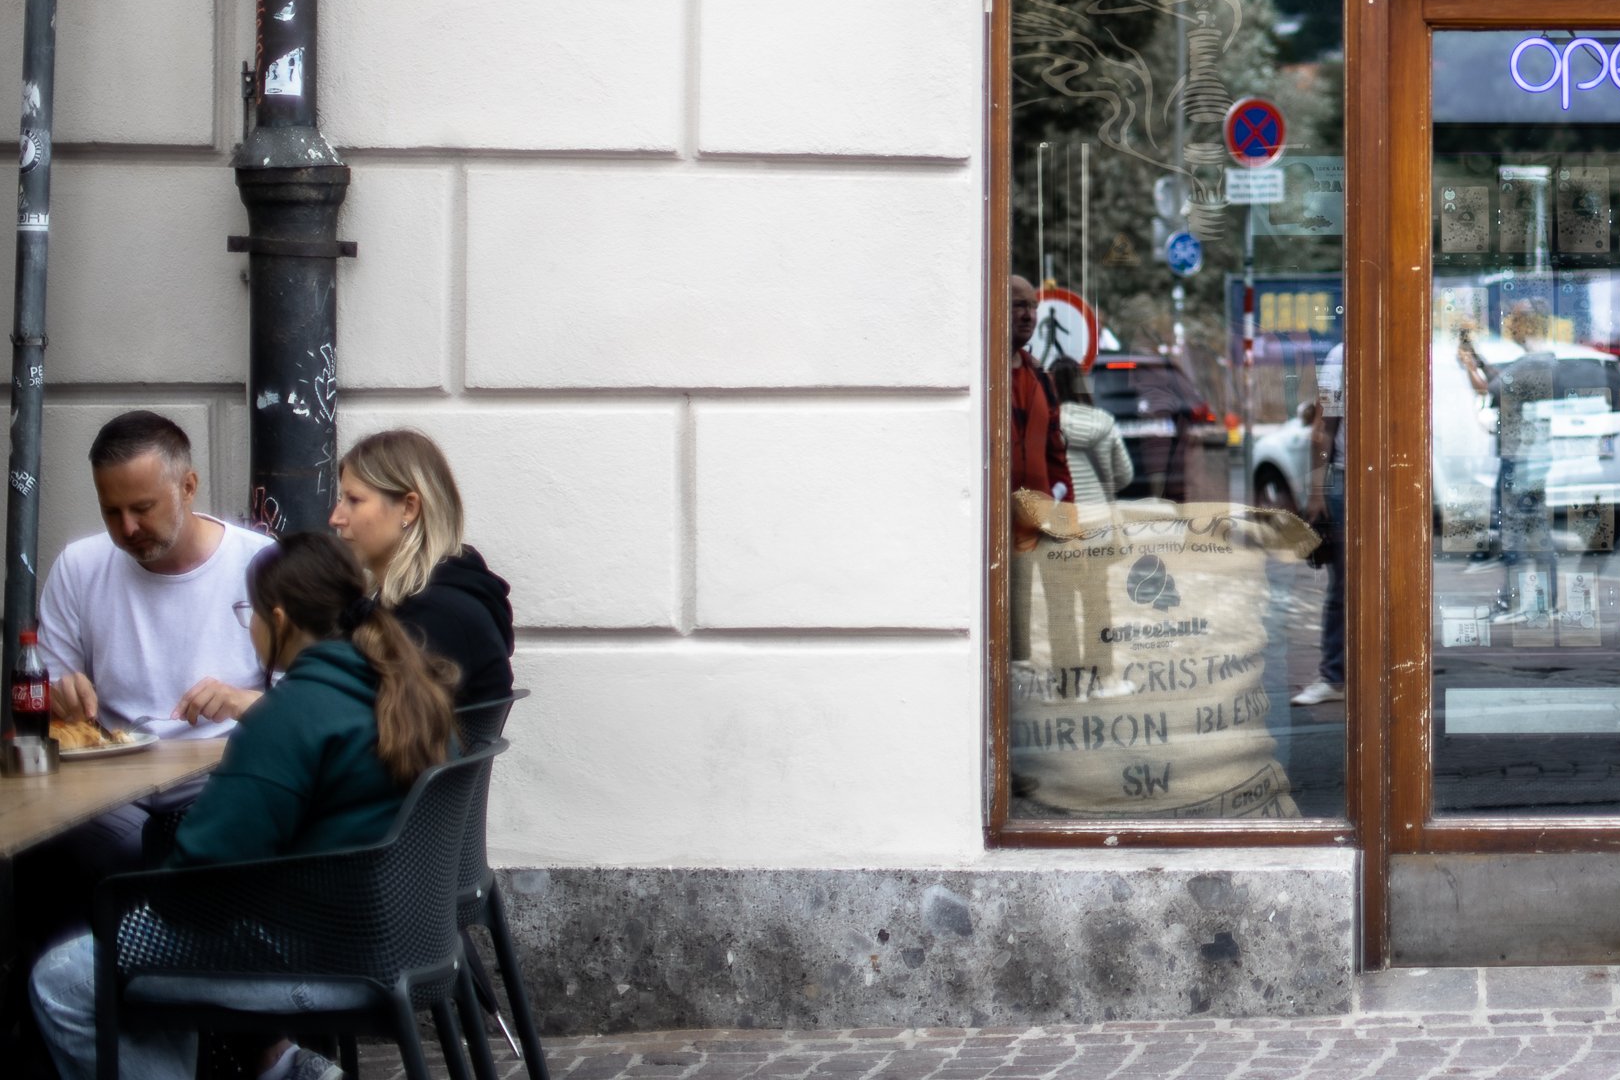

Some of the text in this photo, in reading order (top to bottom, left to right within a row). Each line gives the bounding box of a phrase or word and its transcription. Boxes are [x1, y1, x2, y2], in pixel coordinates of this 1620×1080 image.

[1047, 545, 1114, 561] exporters
[1119, 544, 1134, 555] of
[1138, 542, 1185, 555] quality
